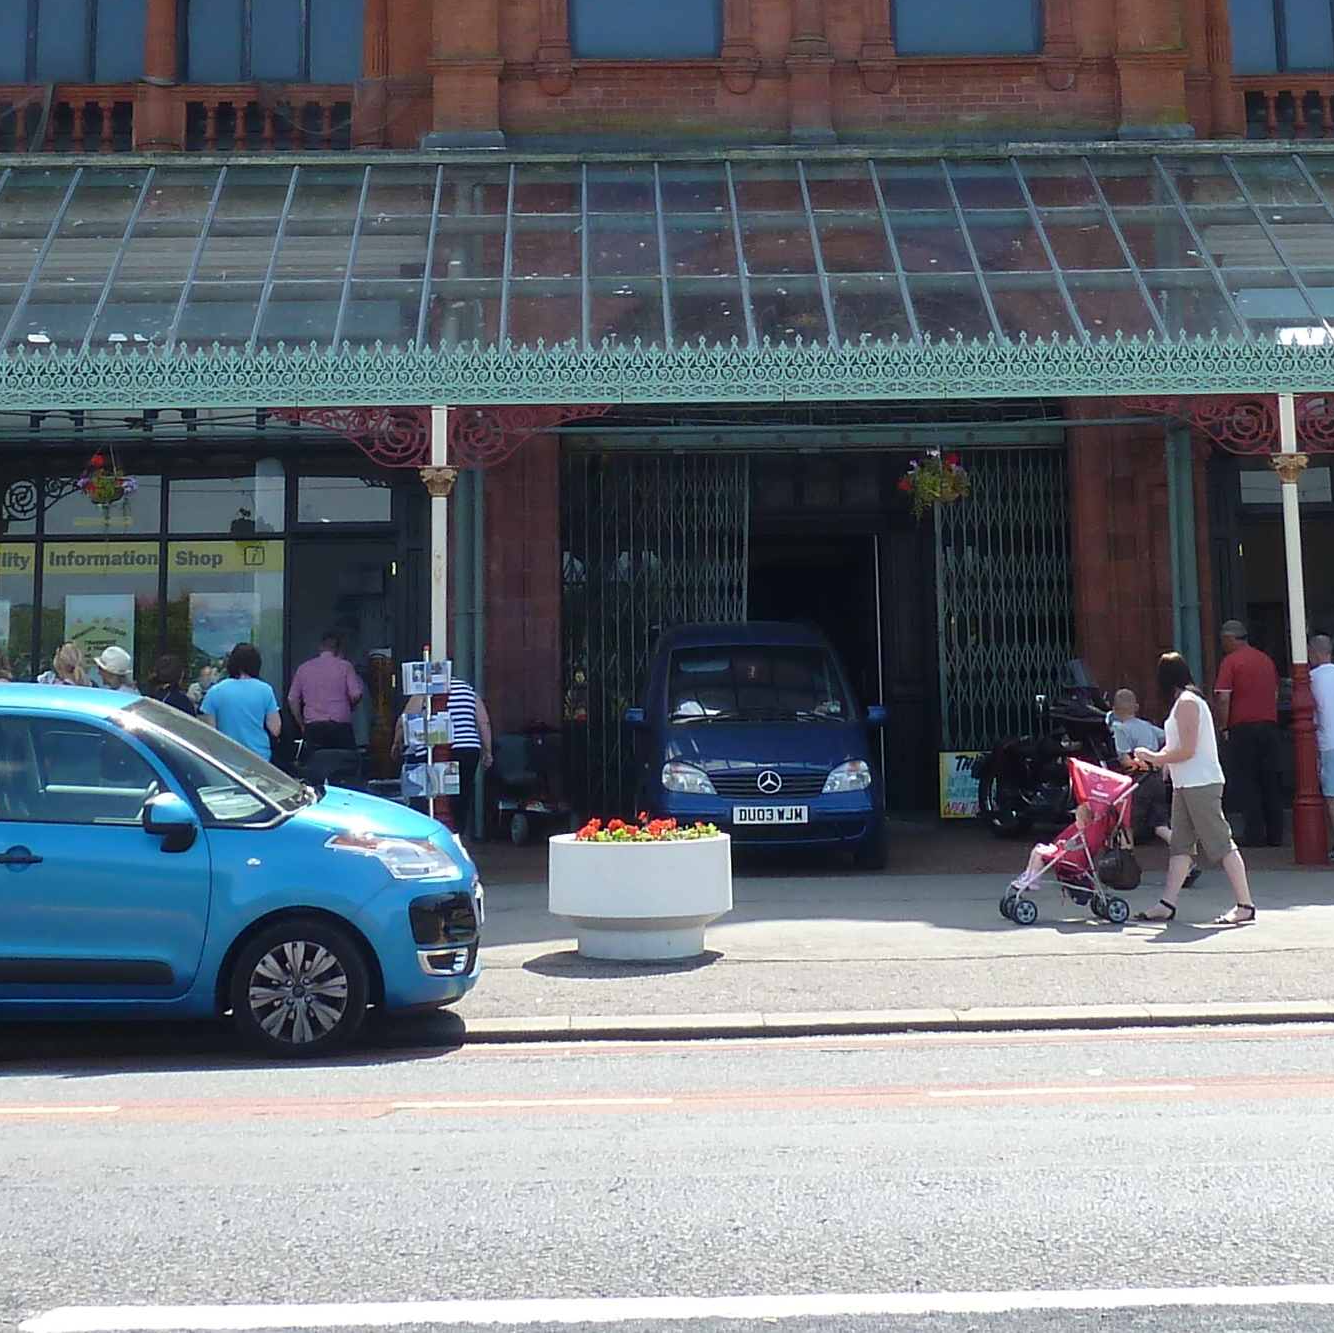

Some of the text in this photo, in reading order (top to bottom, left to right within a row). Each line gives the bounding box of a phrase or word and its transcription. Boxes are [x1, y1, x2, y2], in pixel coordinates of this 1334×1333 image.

[49, 550, 158, 566] Information
[175, 550, 223, 568] Shop
[955, 755, 978, 771] TH
[739, 808, 803, 821] DU03 WJM
